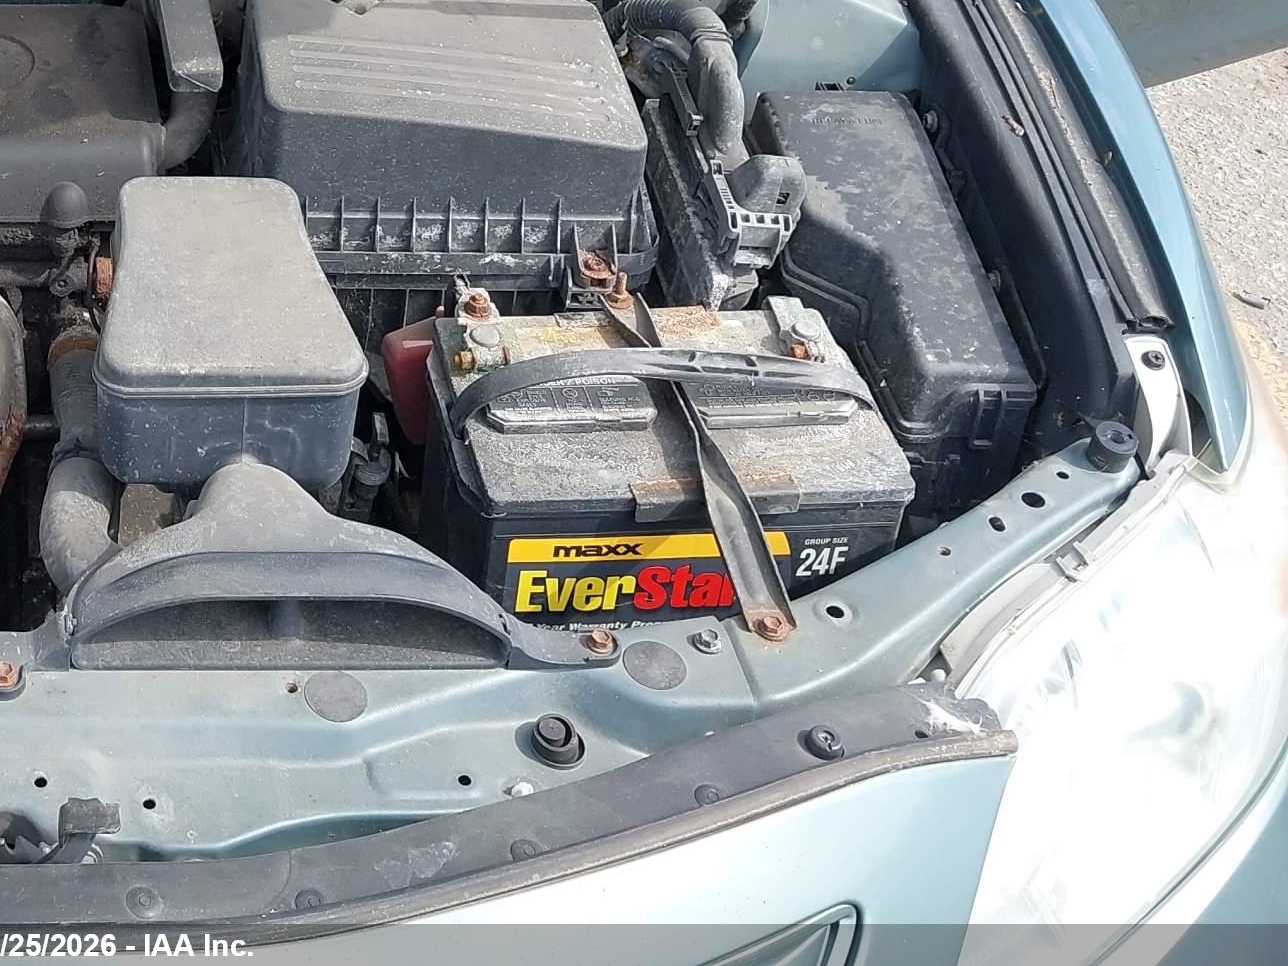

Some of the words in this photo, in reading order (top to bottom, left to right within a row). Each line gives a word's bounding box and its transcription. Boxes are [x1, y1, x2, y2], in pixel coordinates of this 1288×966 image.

[804, 537, 832, 546] GROUP
[832, 536, 849, 544] SIZE
[553, 542, 643, 558] maxx
[795, 546, 849, 577] 24F
